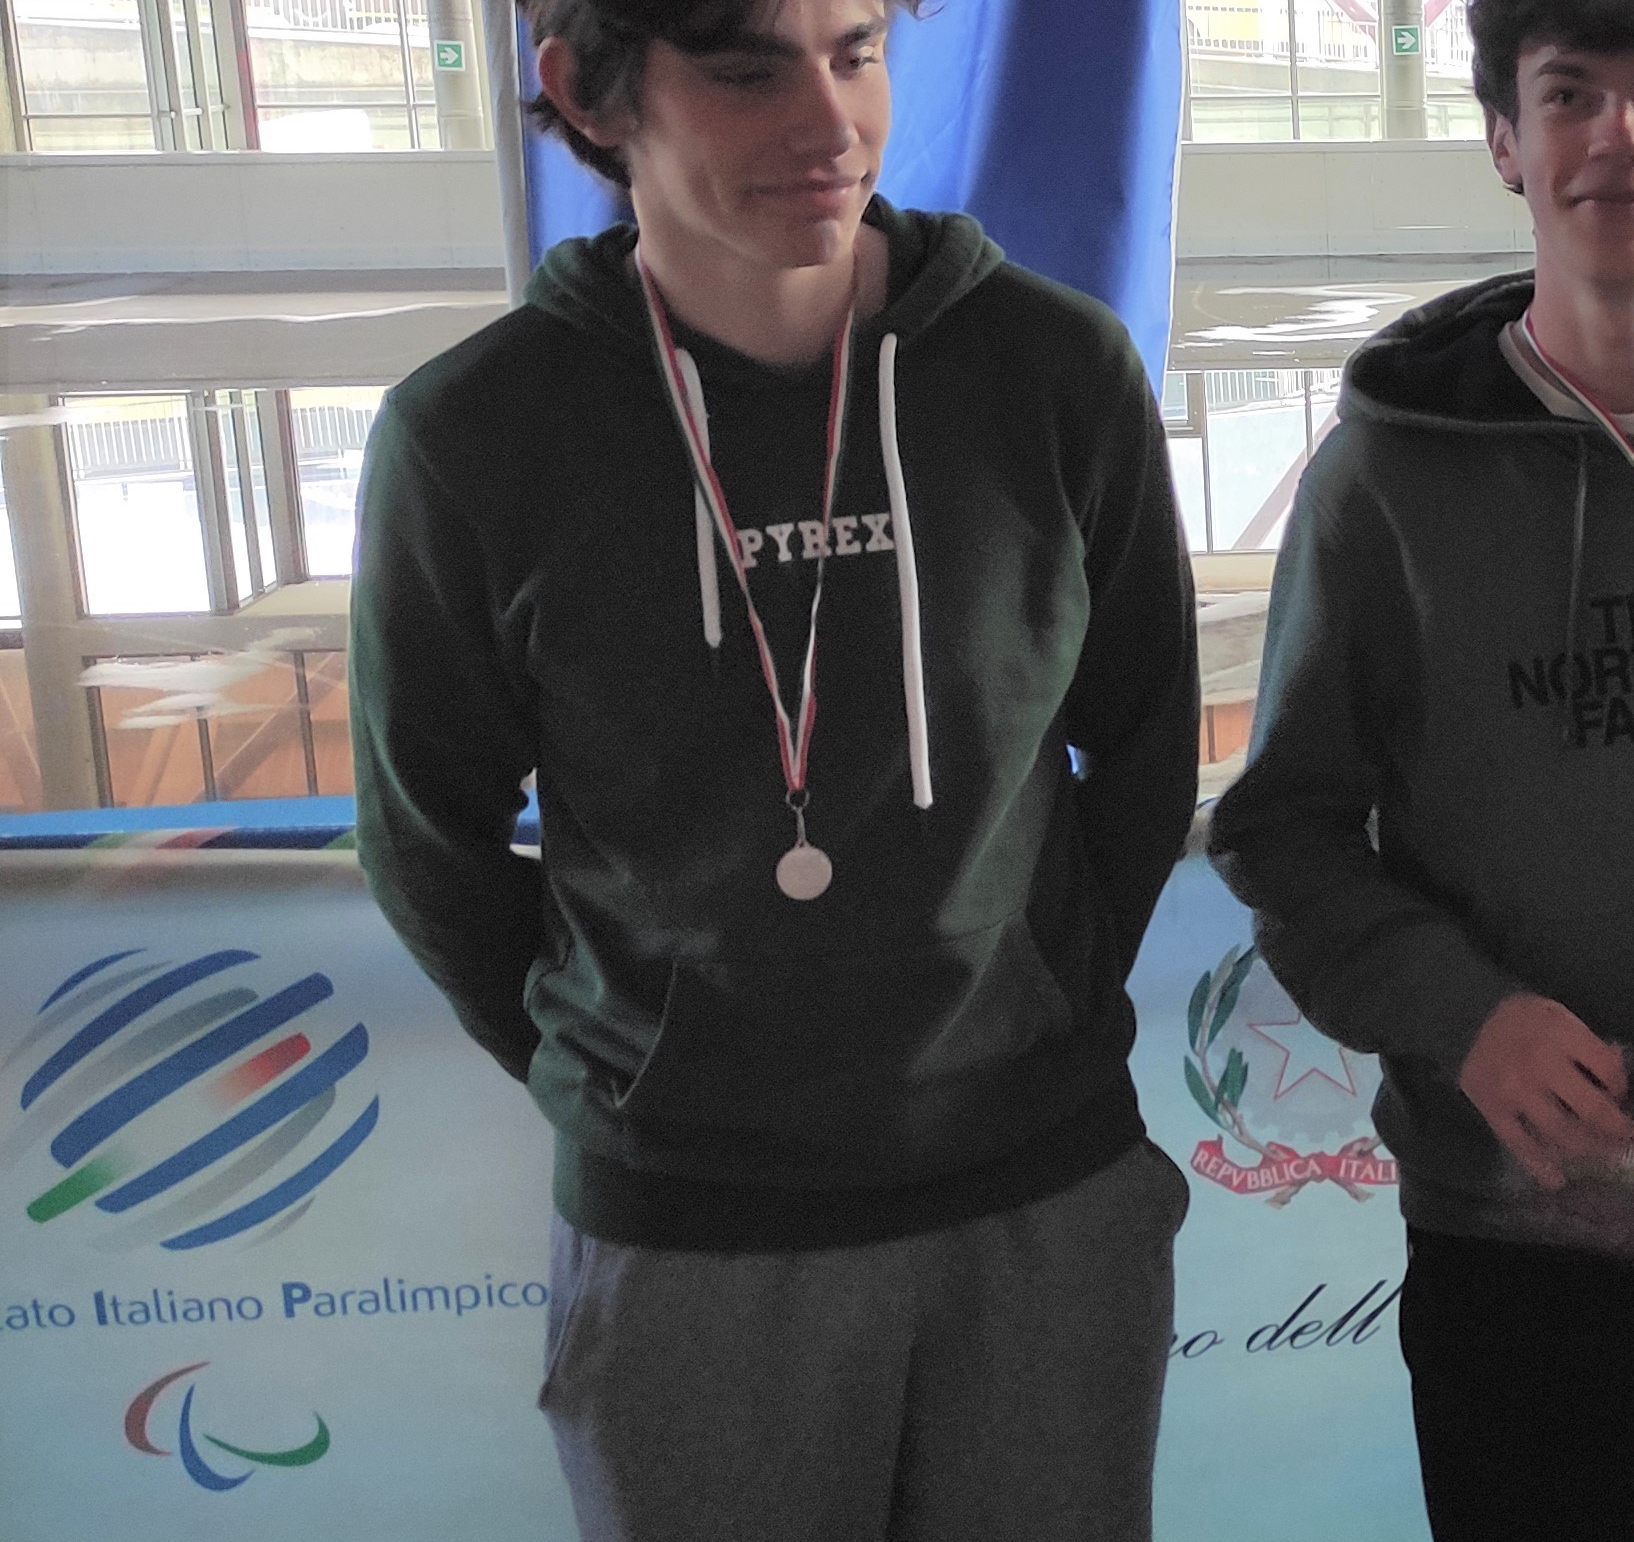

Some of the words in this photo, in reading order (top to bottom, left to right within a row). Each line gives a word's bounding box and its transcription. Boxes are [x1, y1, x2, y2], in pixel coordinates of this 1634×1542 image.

[737, 512, 898, 569] PYREX
[0, 1299, 76, 1330] ato
[93, 1288, 264, 1327] Italiano
[281, 1273, 549, 1328] Paralimpico
